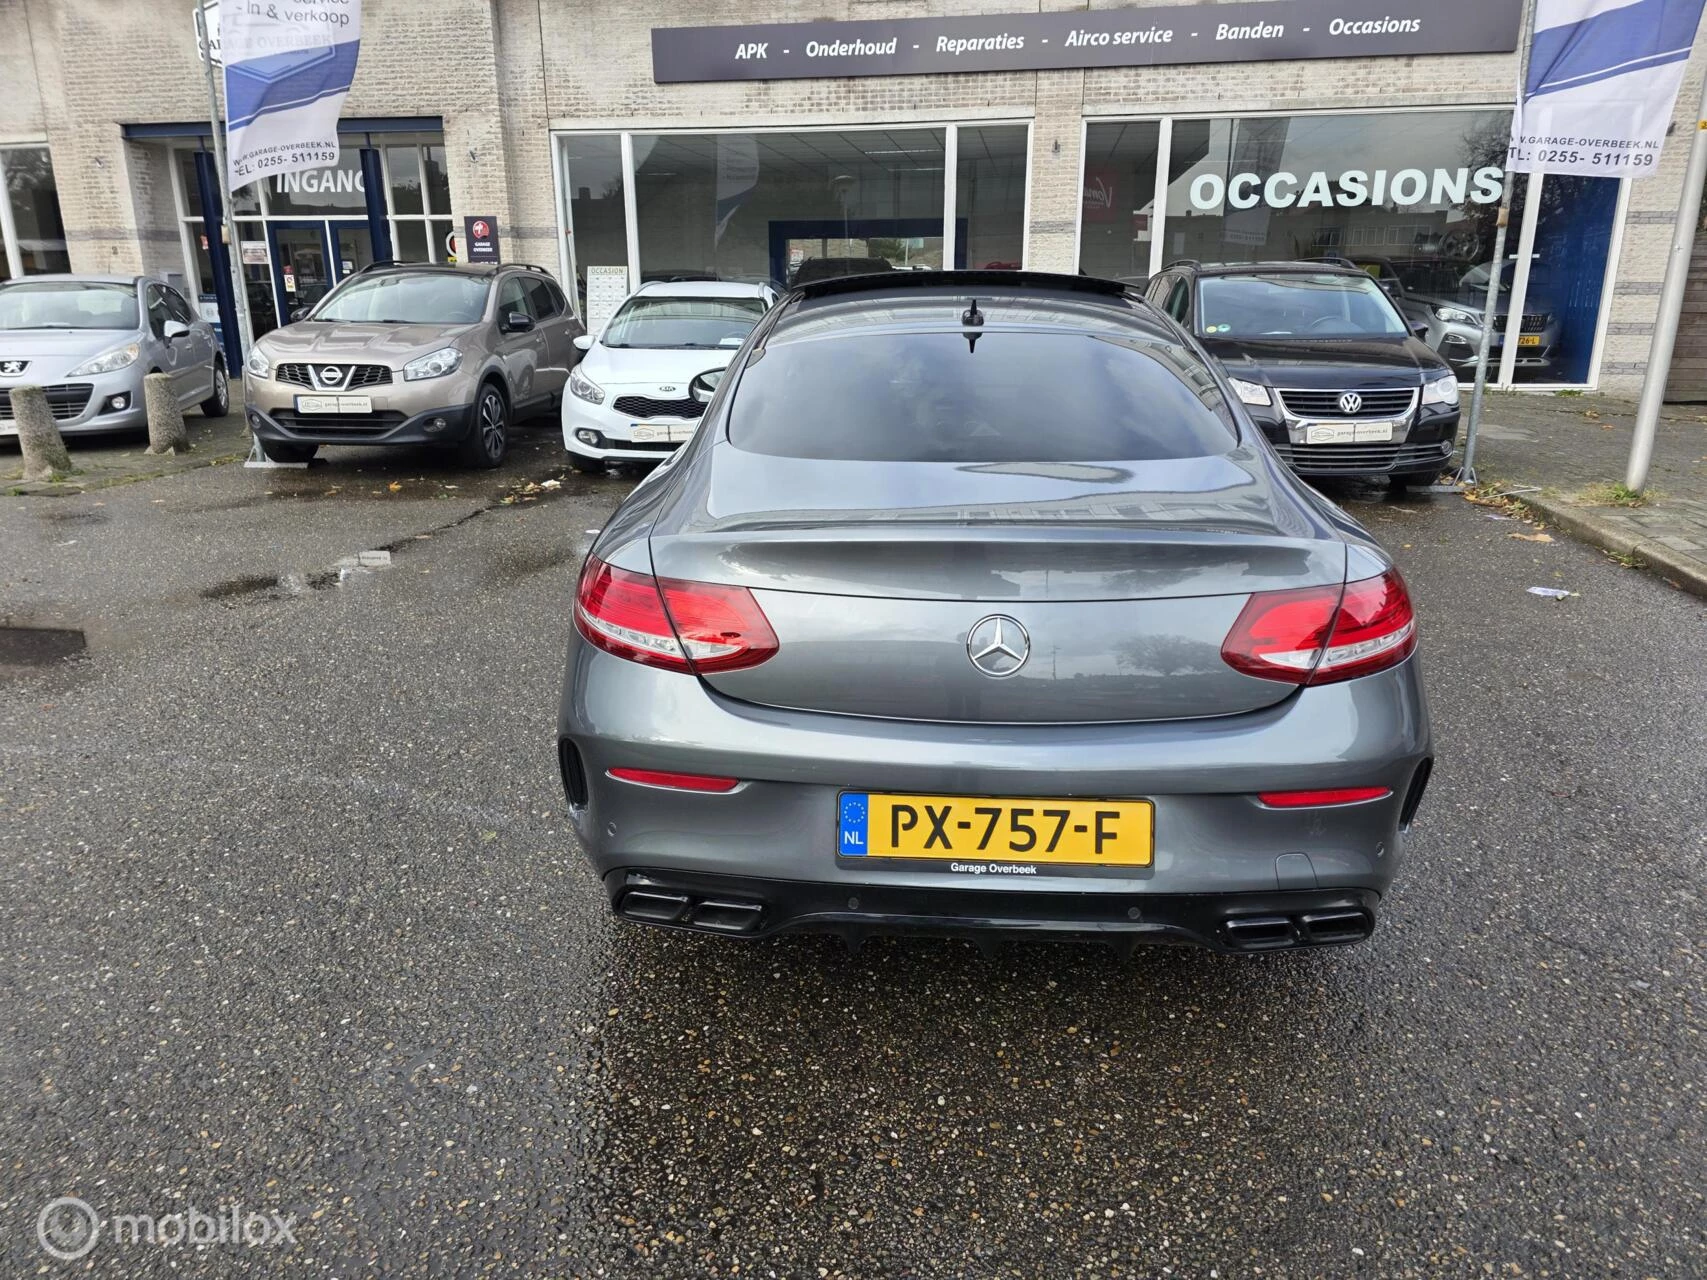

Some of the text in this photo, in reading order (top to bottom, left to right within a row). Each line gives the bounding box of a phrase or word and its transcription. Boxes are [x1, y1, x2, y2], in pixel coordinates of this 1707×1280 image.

[266, 3, 280, 21] &
[285, 10, 350, 28] verkoop
[735, 43, 768, 59] APK
[806, 38, 896, 57] Onderhoud
[936, 33, 1024, 55] Reparaties
[1065, 30, 1109, 47] Airco
[1113, 27, 1173, 45] service
[1216, 21, 1283, 40] Banden
[1329, 16, 1420, 36] Occasions
[257, 156, 287, 169] 0255-
[292, 152, 335, 163] 511159
[1538, 150, 1585, 163] 0255-
[1592, 152, 1653, 166] 511159
[1189, 167, 1503, 209] OCCASIONS
[590, 267, 624, 275] OCCASION
[891, 804, 1121, 854] PX-757-F
[844, 831, 864, 845] NL
[950, 863, 1037, 875] Garage Overbeek
